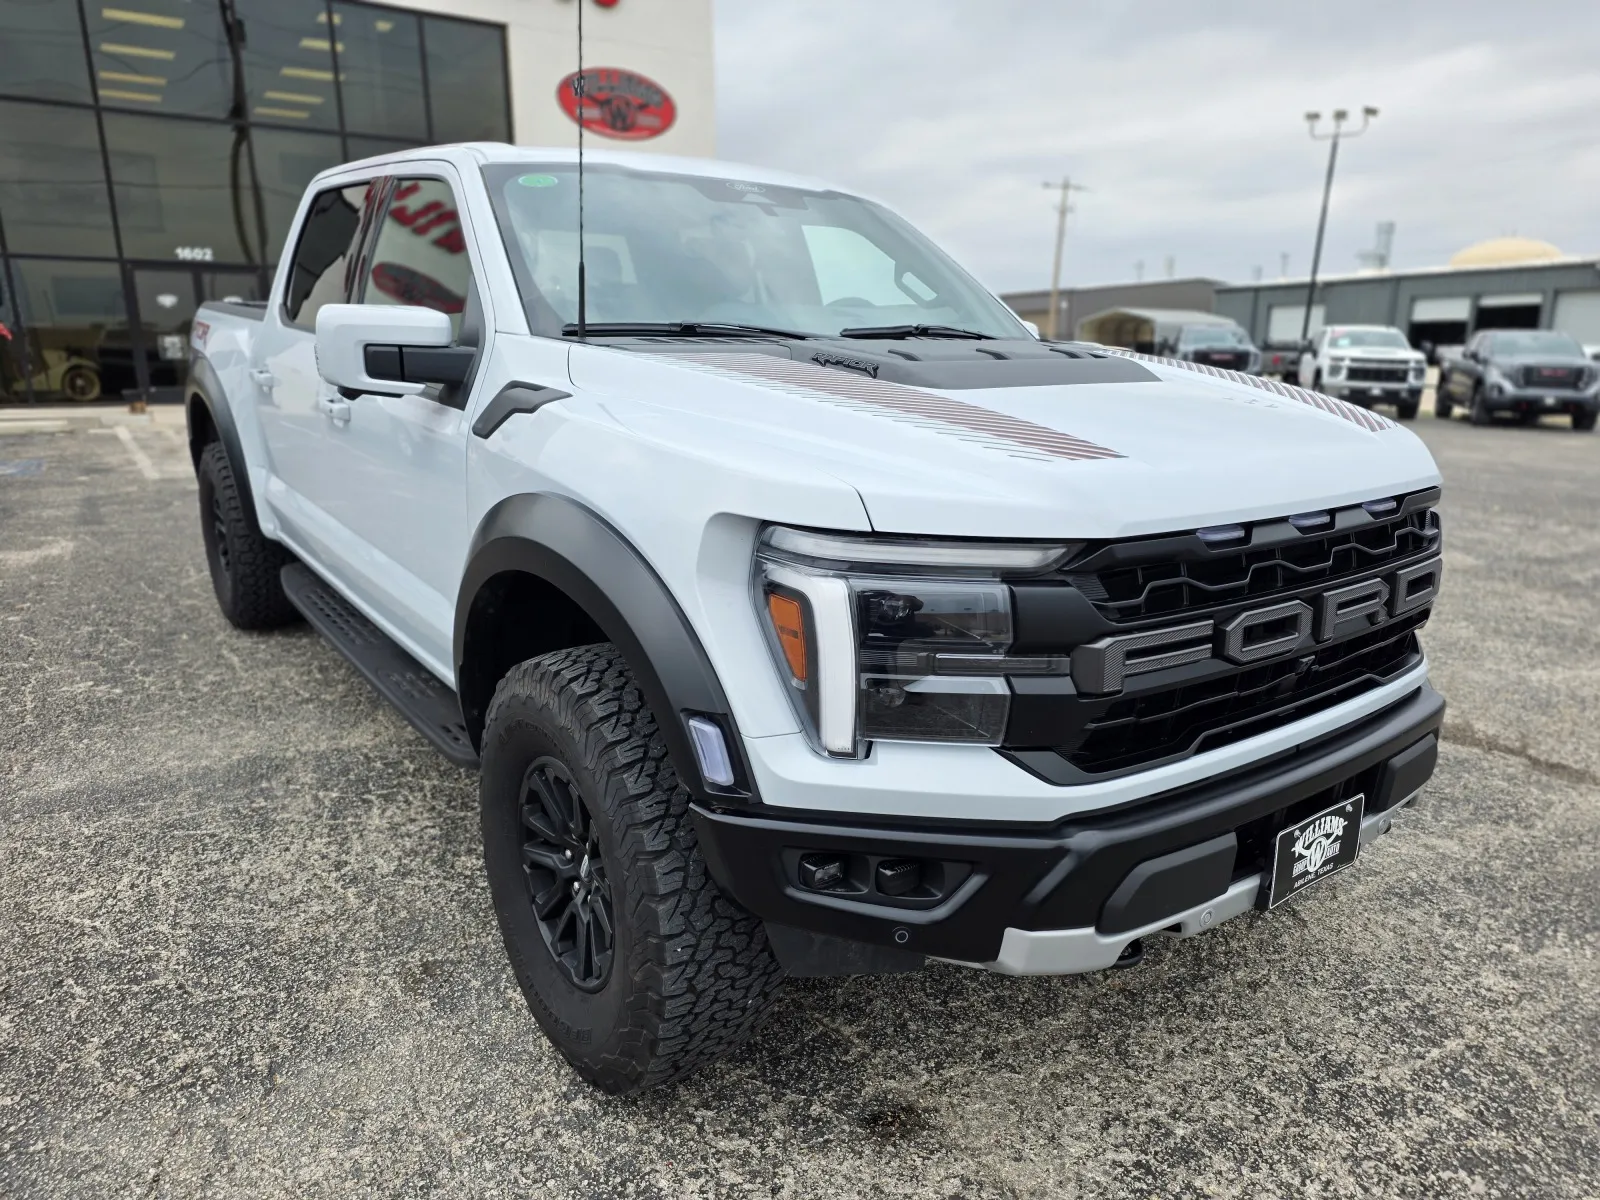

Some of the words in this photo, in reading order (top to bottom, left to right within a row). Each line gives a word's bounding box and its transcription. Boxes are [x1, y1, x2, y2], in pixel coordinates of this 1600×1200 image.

[175, 246, 213, 261] 1602
[811, 352, 879, 379] RAPTOR
[1071, 557, 1443, 701] FORD
[1294, 815, 1344, 858] WILLIAMS
[1317, 862, 1335, 876] TEXAS
